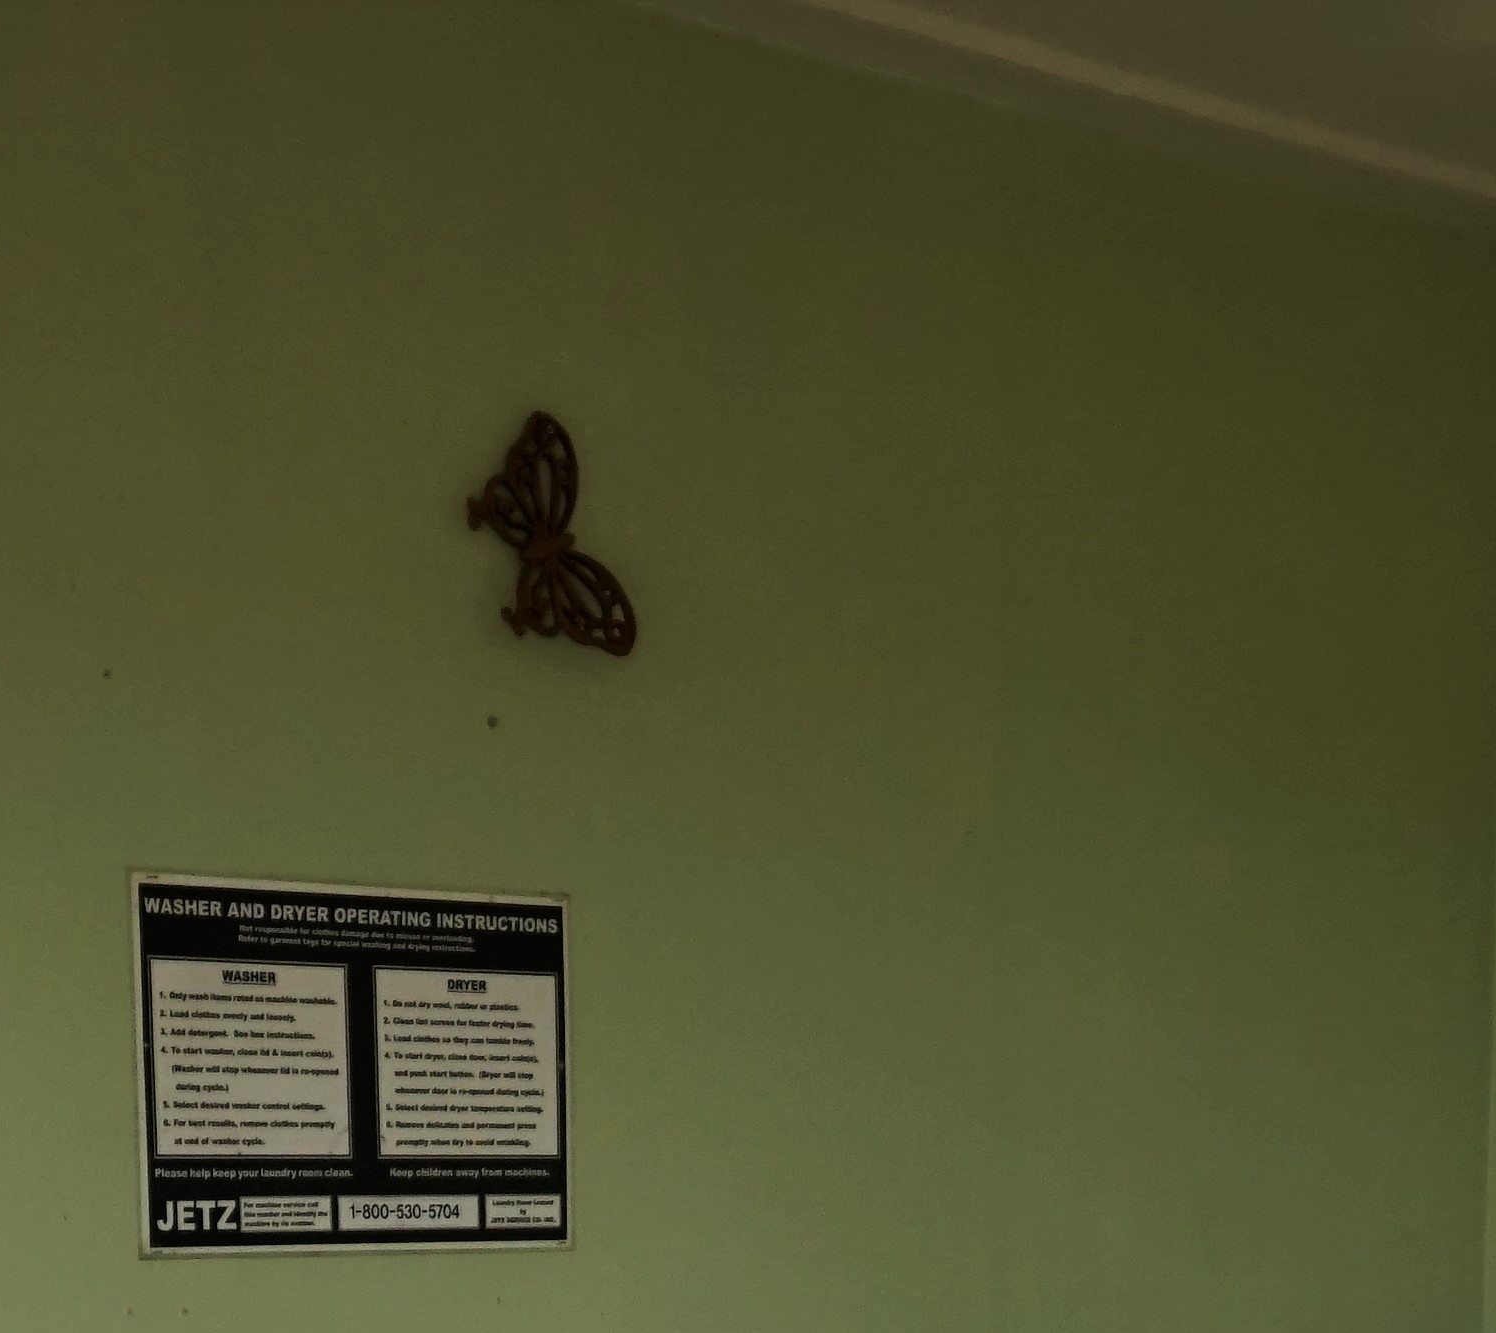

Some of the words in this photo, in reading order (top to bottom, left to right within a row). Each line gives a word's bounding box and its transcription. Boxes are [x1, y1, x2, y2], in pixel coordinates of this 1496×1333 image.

[144, 897, 222, 917] WASHER
[227, 902, 265, 919] AND
[270, 903, 329, 922] DRYER
[334, 907, 431, 927] OPERATING
[436, 912, 559, 934] INSTRUCTIONS
[222, 970, 276, 983] WASHER
[447, 979, 486, 991] DRYER
[161, 1046, 168, 1054] 4.
[169, 1046, 181, 1054] To
[182, 1046, 202, 1055] start
[155, 1168, 187, 1178] Please
[189, 1168, 211, 1180] help
[212, 1168, 236, 1180] keep
[237, 1170, 259, 1180] your
[260, 1168, 296, 1180] laundry
[298, 1170, 322, 1178] room
[324, 1168, 353, 1178] clean.
[390, 1168, 414, 1180] Keep
[415, 1168, 453, 1178] children
[455, 1170, 479, 1180] away
[481, 1168, 502, 1178] from
[504, 1168, 549, 1178] machines.
[156, 1199, 238, 1232] JETZ
[349, 1203, 460, 1220] 1-800-530-5704
